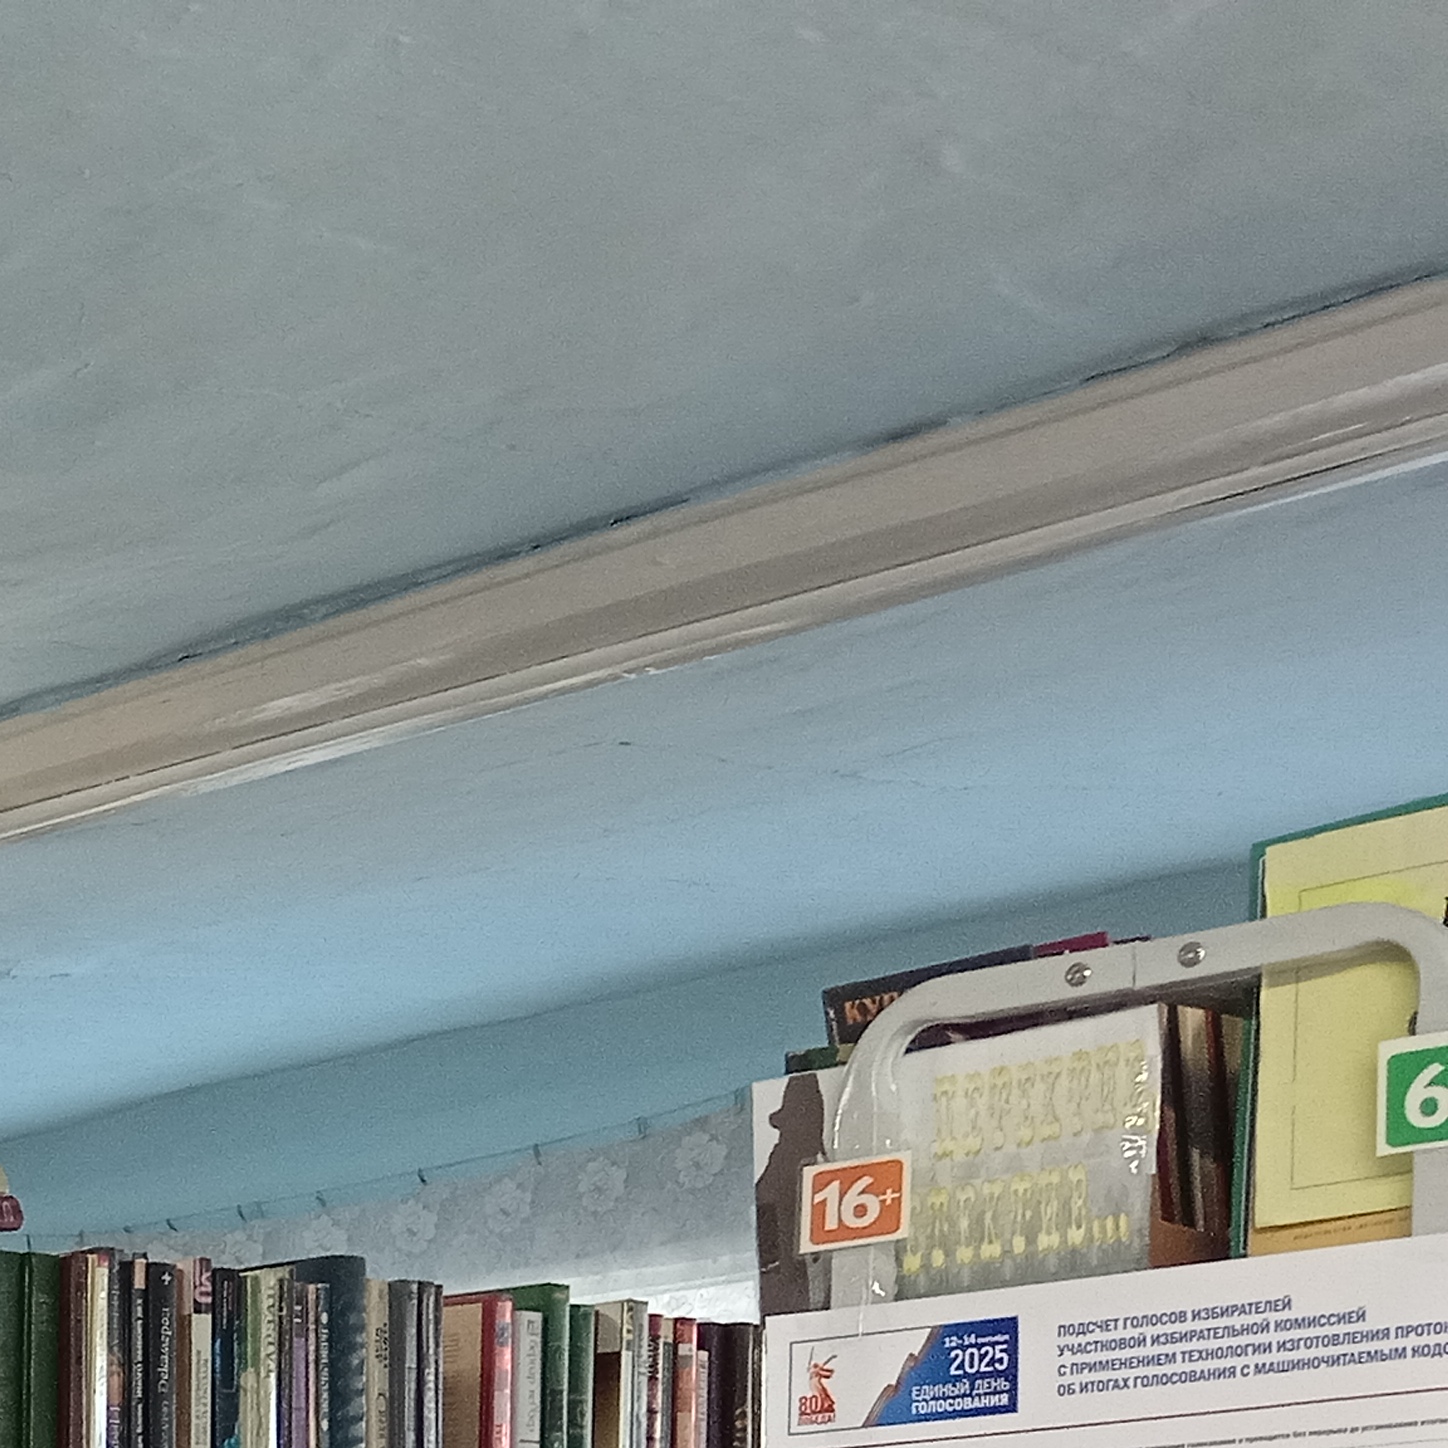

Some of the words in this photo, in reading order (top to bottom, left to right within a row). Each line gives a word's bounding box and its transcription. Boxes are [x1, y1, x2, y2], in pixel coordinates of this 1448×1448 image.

[813, 1173, 900, 1233] 16+
[1057, 1318, 1120, 1338] ПОДСЧЕТ
[1122, 1309, 1189, 1330] ГОЛОСОВ
[1191, 1294, 1293, 1324] ИЗБИРАТЕЛЕЙ
[1057, 1333, 1148, 1358] УЧАСТКОВОЙ
[1150, 1319, 1271, 1348] ИЗБИРАТЕЛЬНОЙ
[1274, 1306, 1367, 1333] КОМИССИЕЙ
[158, 1307, 172, 1393] Декамерон
[944, 1335, 977, 1348] 12-14
[949, 1344, 1010, 1376] 2025
[1057, 1364, 1068, 1378] С
[1069, 1351, 1178, 1377] ПРИМЕНЕНИЕМ
[1180, 1340, 1273, 1364] ТЕХНОЛОГИИ
[1276, 1327, 1391, 1355] ИЗГОТОВЛЕНИЯ
[911, 1379, 971, 1399] ЕДИНЫЙ
[973, 1378, 1011, 1395] ДЕНЬ
[1057, 1382, 1076, 1398] ОБ
[1078, 1377, 1131, 1395] ИТОГАХ
[1133, 1364, 1237, 1390] ГОЛОСОВАНИЯ
[1240, 1363, 1251, 1378] С
[1253, 1347, 1408, 1377] МАШИНОЧИТАЕМЫМ
[911, 1393, 1009, 1416] ГОЛОСОВАНИЯ
